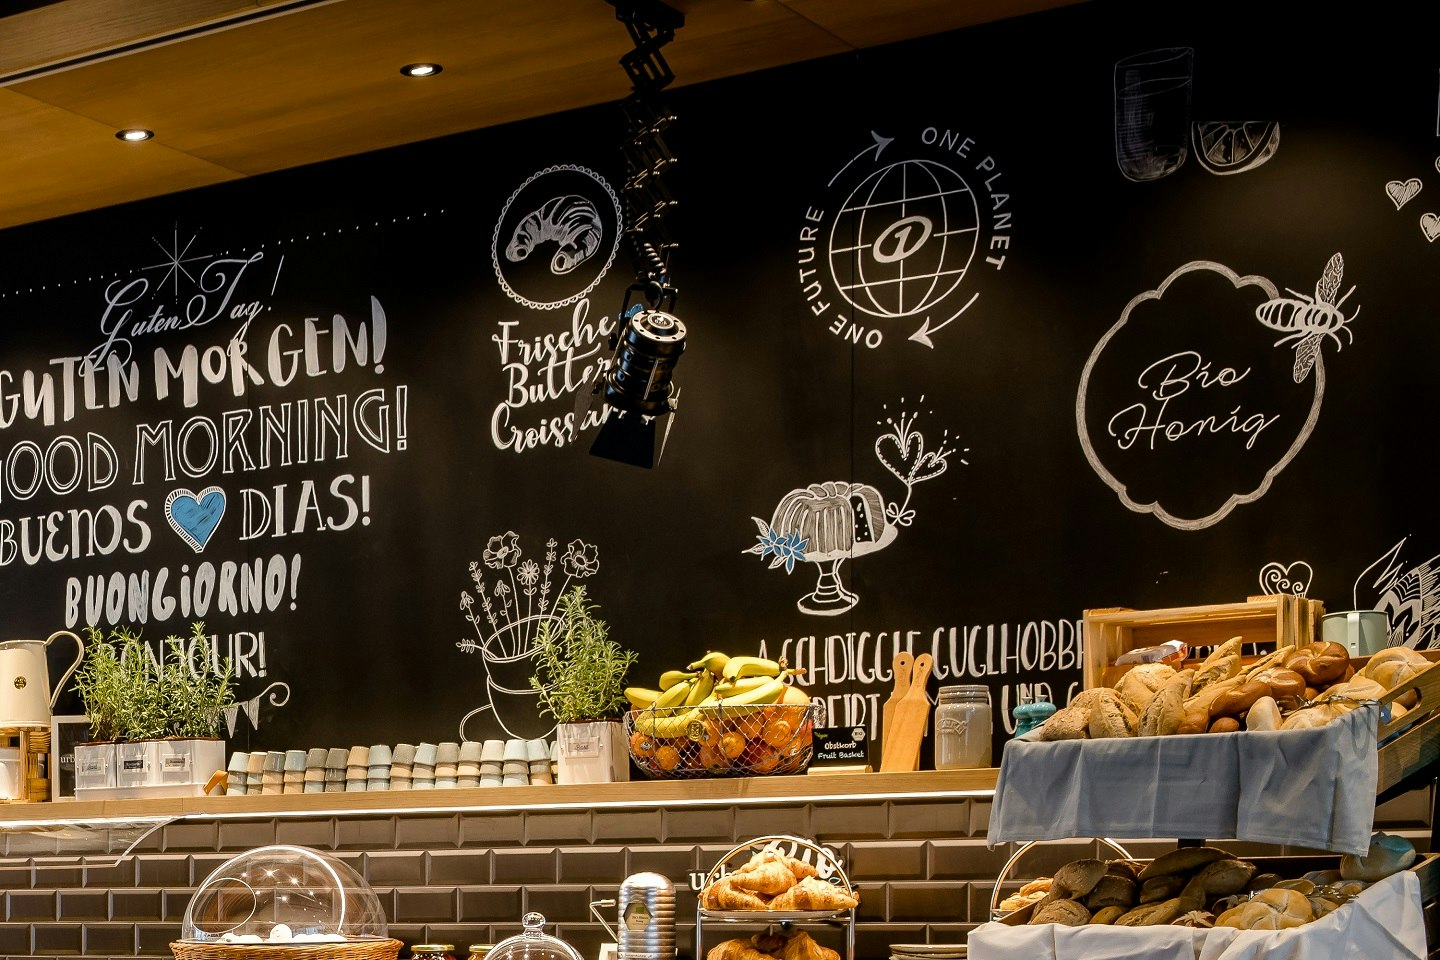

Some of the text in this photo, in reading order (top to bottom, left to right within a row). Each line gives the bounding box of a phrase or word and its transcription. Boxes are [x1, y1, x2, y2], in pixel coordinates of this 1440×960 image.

[921, 126, 1012, 271] ONE PLANET
[797, 206, 883, 349] ONE FUTURE
[77, 251, 285, 378] Guten Tag!
[491, 298, 617, 366] Frische
[153, 294, 388, 408] MORGEN!
[1138, 350, 1251, 400] Bio
[132, 385, 408, 485] MORNING!
[1108, 397, 1281, 450] Honig
[239, 474, 371, 541] DIAS!
[817, 750, 865, 760] Fruit Basket
[824, 740, 857, 750] Obstkorb
